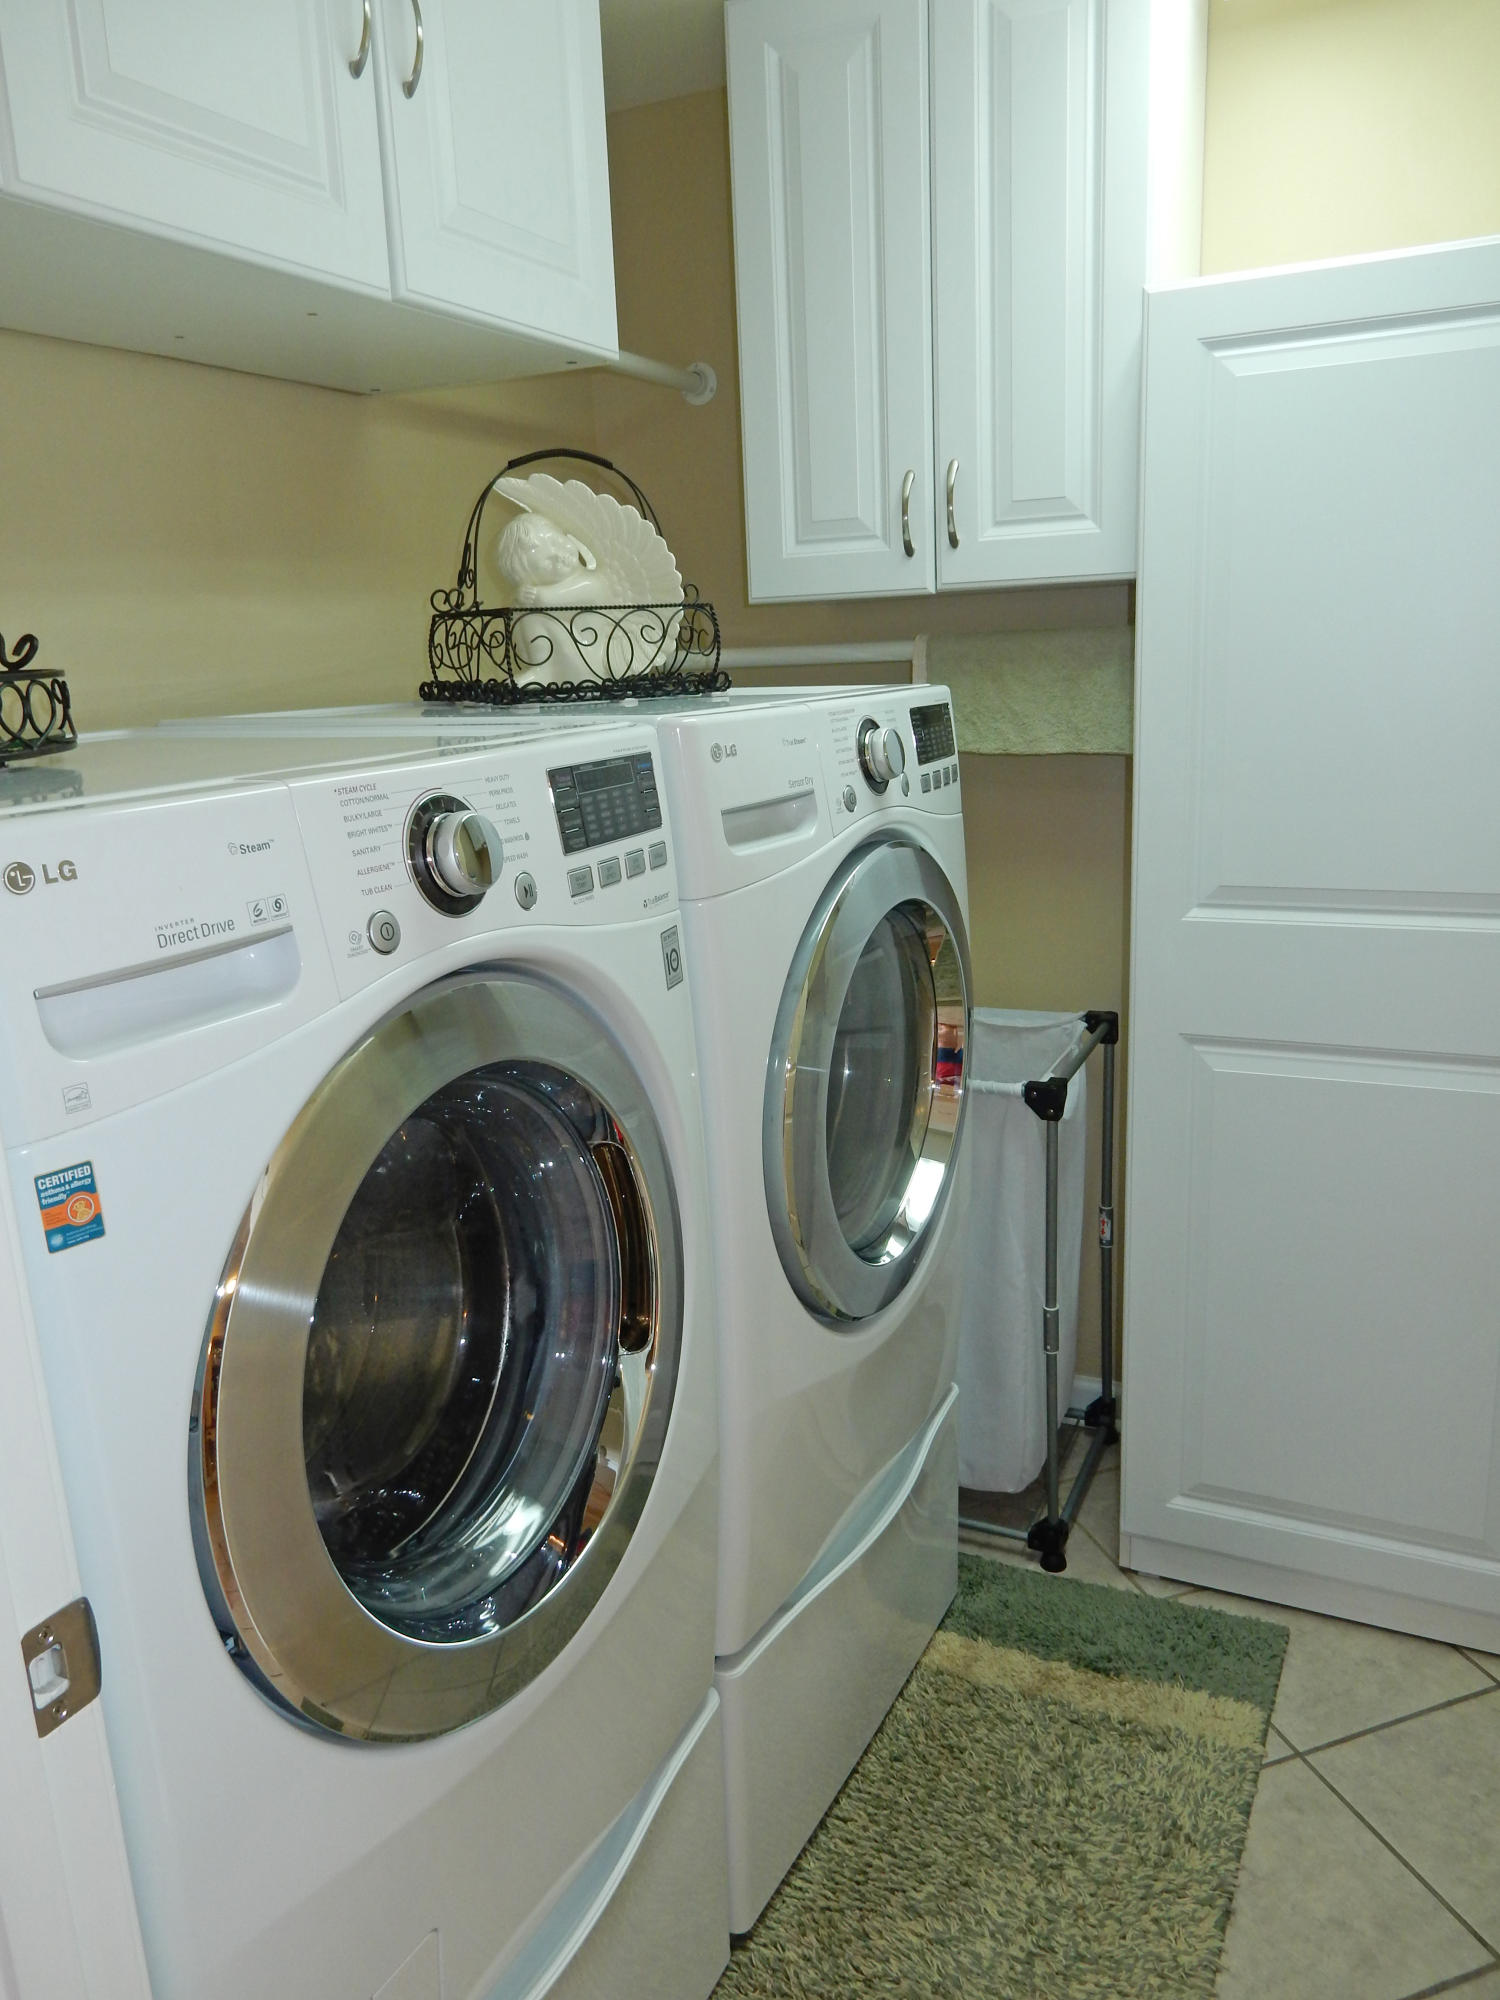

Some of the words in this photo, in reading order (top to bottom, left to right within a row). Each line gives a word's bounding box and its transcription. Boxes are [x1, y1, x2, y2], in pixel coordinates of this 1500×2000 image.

[724, 743, 738, 758] LG
[359, 782, 377, 793] CYCLE
[347, 828, 368, 840] BRIGHT
[351, 845, 381, 858] SANITARY
[41, 859, 79, 885] LG
[361, 888, 374, 898] TUB
[373, 883, 393, 895] CLEAN
[154, 917, 195, 932] INVERTER
[37, 1165, 92, 1190] CERTIFIED
